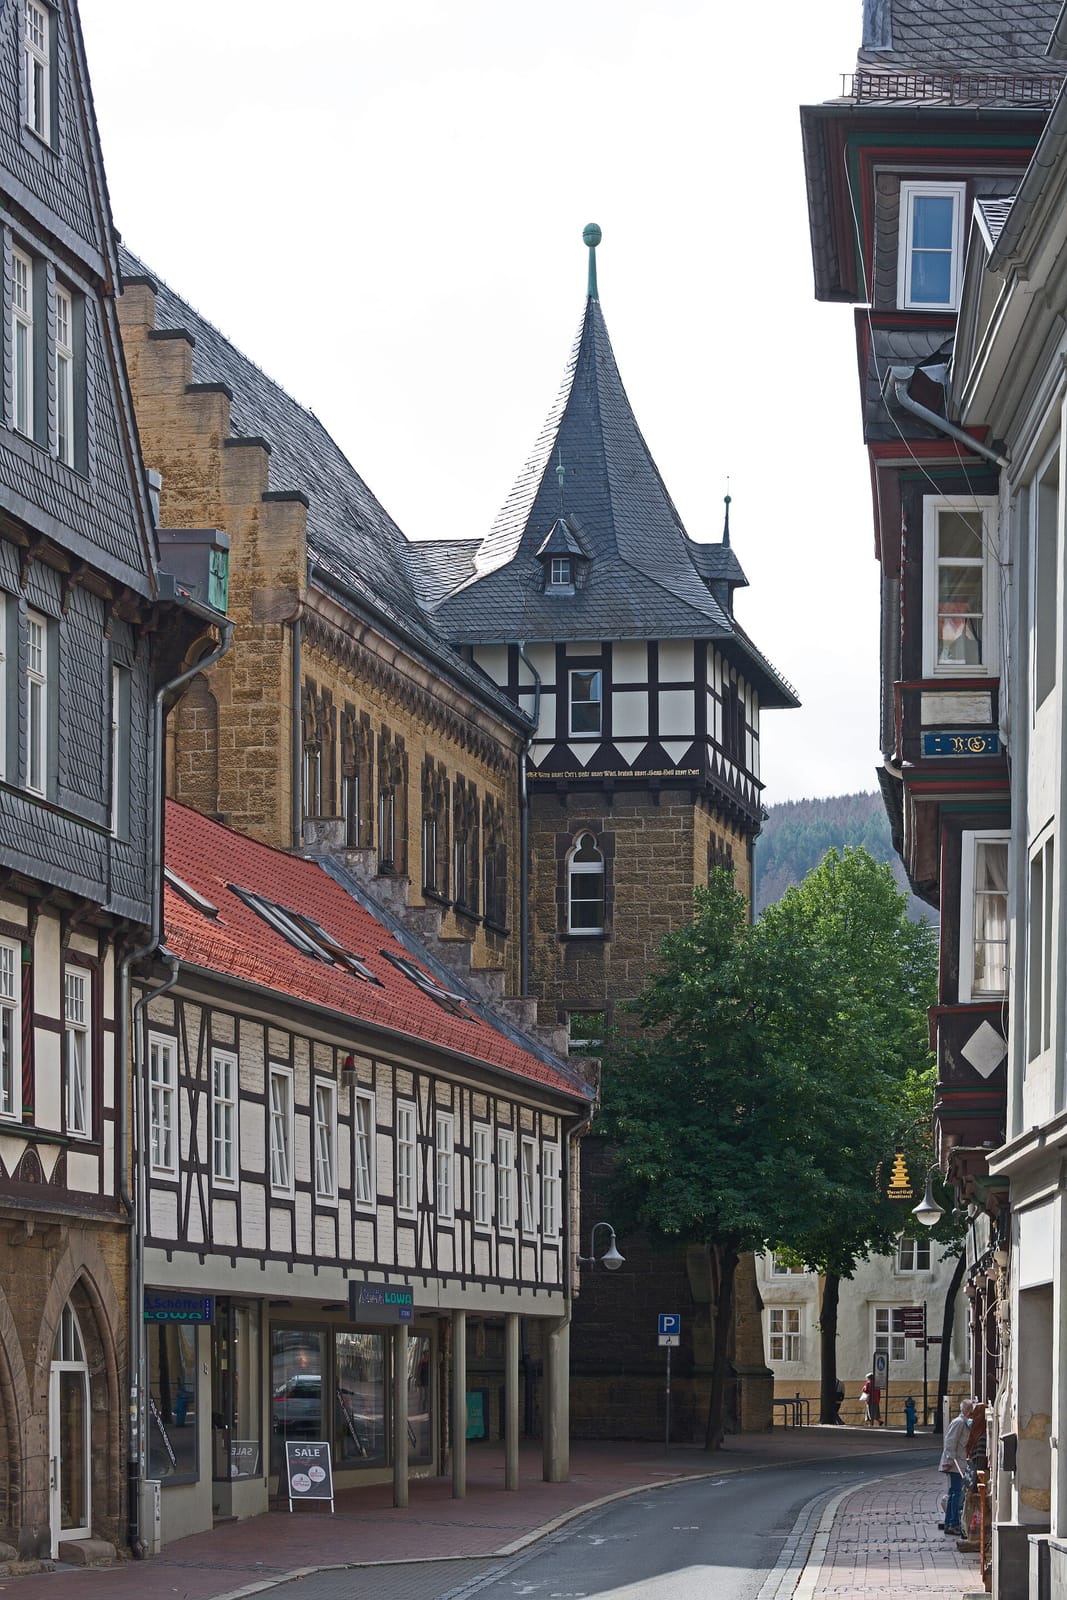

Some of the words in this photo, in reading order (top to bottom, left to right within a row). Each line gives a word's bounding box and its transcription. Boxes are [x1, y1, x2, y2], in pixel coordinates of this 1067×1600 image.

[384, 1291, 412, 1305] LOWA
[143, 1311, 203, 1320] LOWA
[663, 1316, 676, 1332] P
[294, 1448, 320, 1457] SALE
